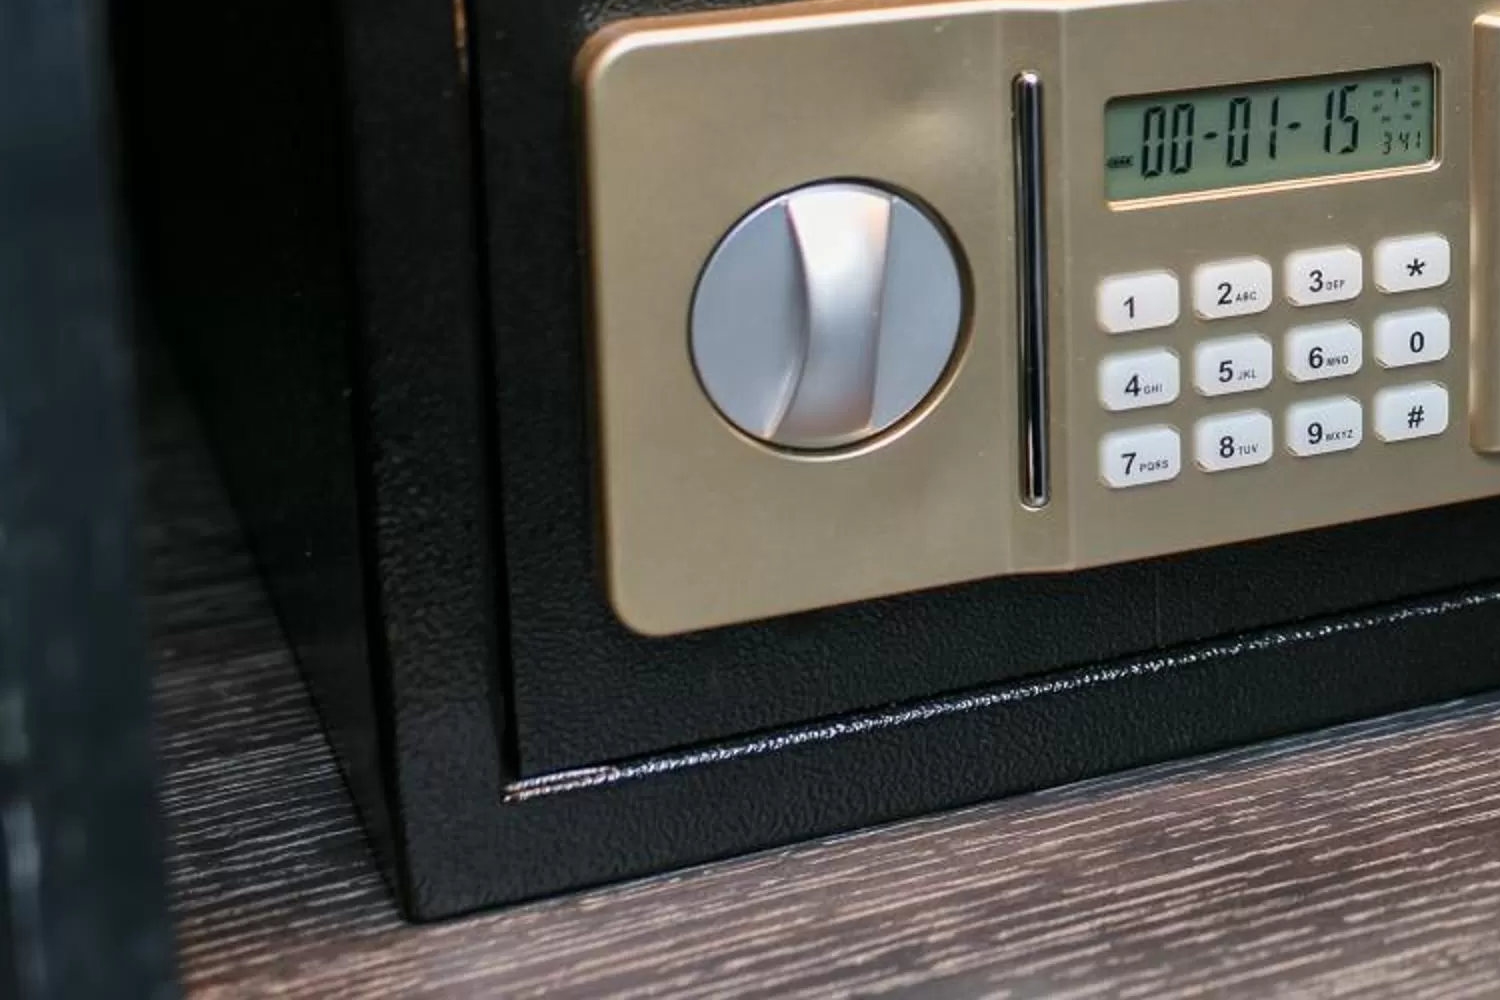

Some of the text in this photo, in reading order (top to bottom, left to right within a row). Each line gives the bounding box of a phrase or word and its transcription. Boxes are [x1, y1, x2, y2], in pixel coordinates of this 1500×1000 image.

[1308, 269, 1346, 293] 3 DEF
[1217, 281, 1257, 306] 2 ABC
[1123, 297, 1136, 319] 1
[1409, 331, 1425, 353] 0
[1308, 347, 1349, 369] 6 MNO
[1218, 360, 1257, 383] 5 JKL
[1124, 375, 1163, 397] 4 GHI
[1407, 405, 1425, 429] #
[1307, 421, 1323, 444] 9
[1218, 435, 1259, 458] 8 TUV
[1121, 452, 1169, 475] 7 PQRS
